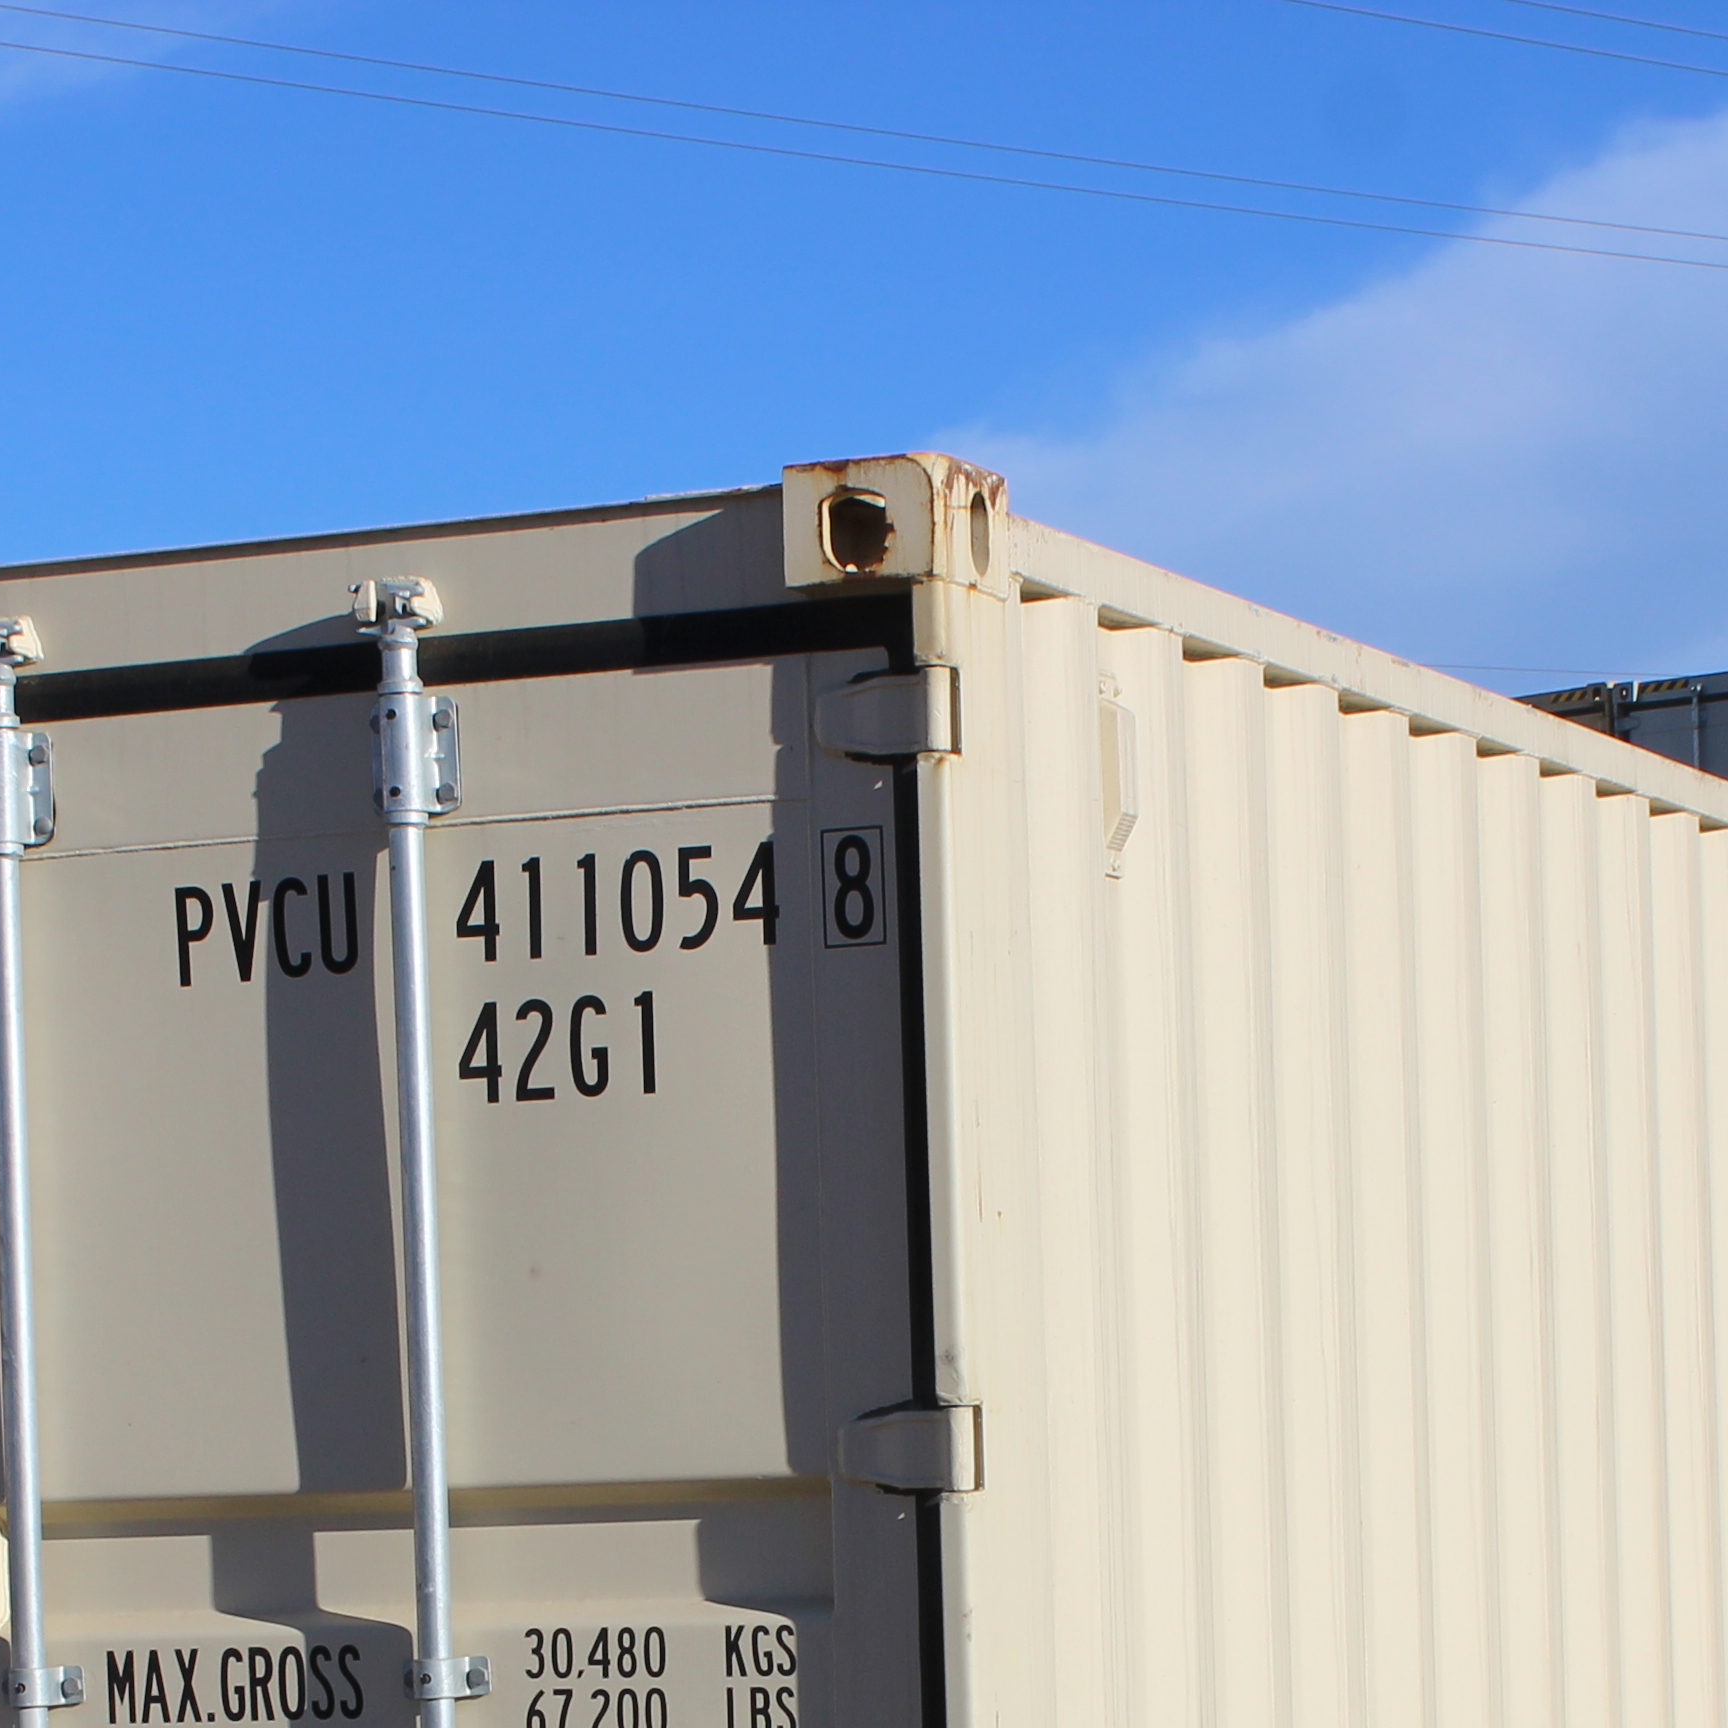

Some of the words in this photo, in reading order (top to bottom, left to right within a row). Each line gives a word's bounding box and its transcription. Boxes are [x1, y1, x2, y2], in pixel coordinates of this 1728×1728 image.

[174, 871, 360, 988] PVCU
[455, 840, 780, 963] 411054
[833, 833, 875, 941] 8
[458, 990, 658, 1104] 42G1
[105, 1644, 366, 1725] MAX.GROSS
[523, 1625, 668, 1681] 30,480
[724, 1623, 799, 1678] KGS
